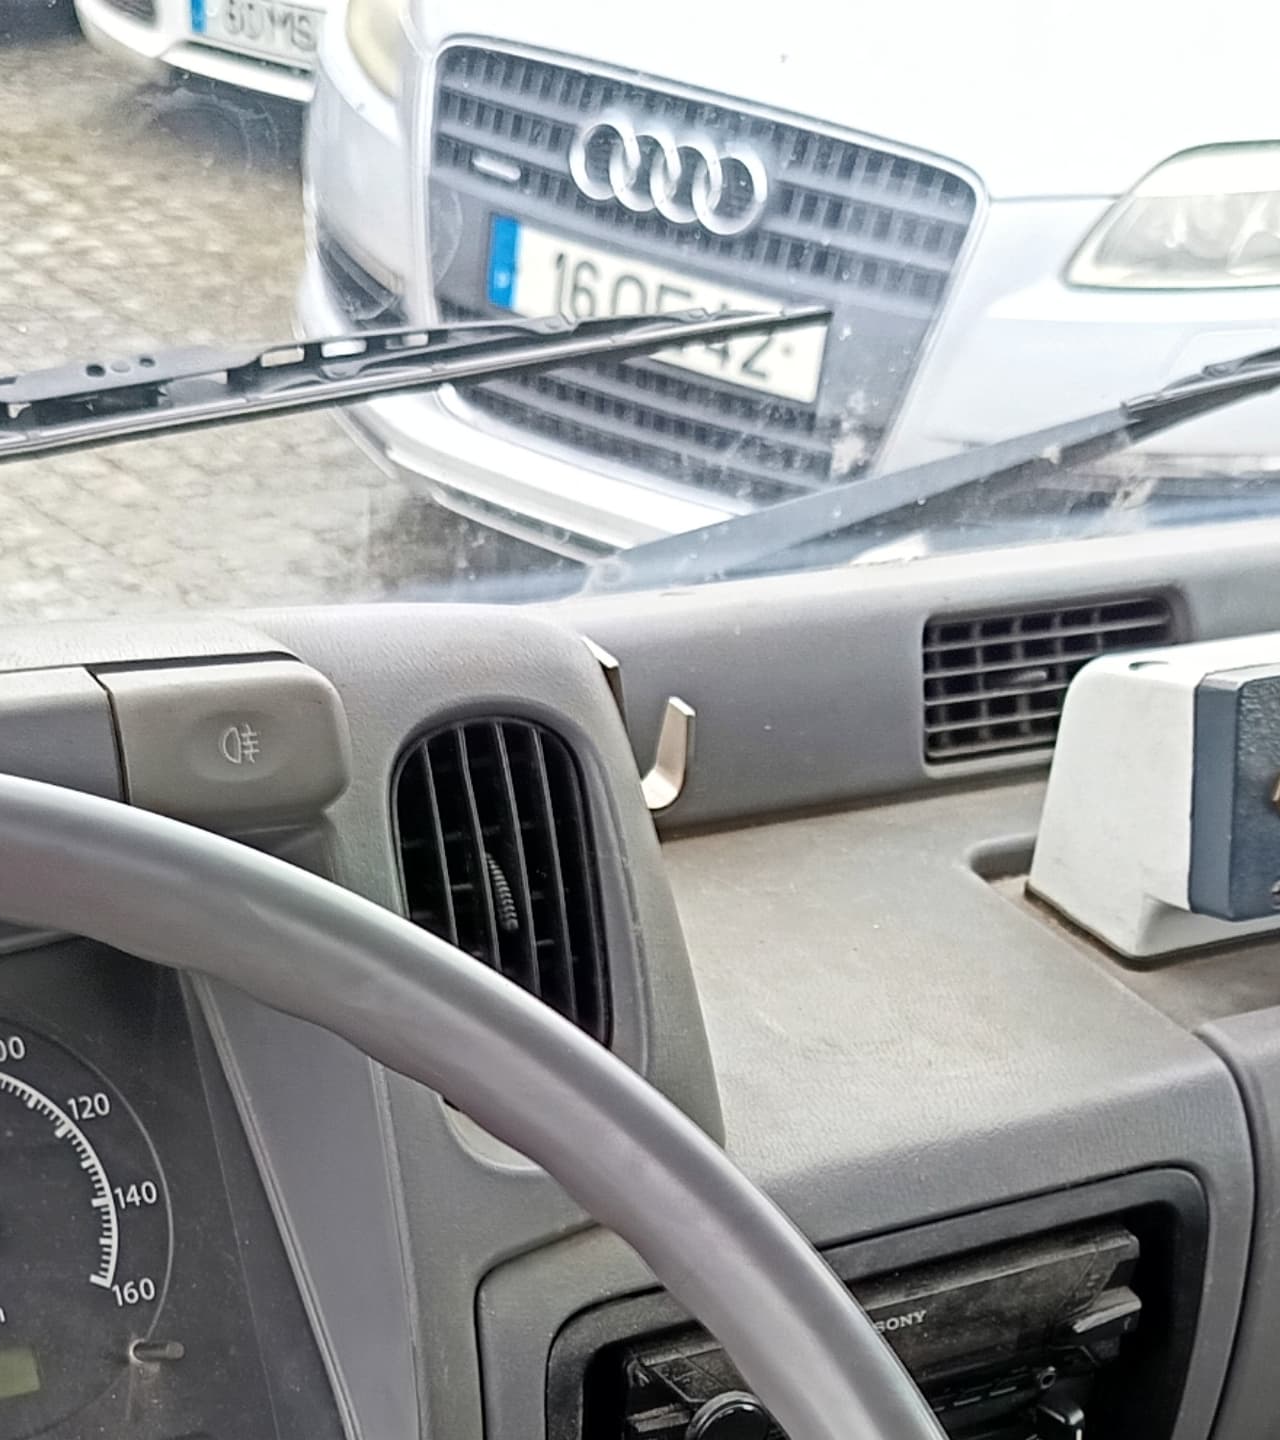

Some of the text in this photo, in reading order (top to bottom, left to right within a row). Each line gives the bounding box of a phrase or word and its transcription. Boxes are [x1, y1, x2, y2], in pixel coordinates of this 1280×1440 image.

[68, 1093, 110, 1121] 120
[113, 1181, 158, 1209] 140
[110, 1277, 156, 1307] 160
[874, 1309, 927, 1332] SONY
